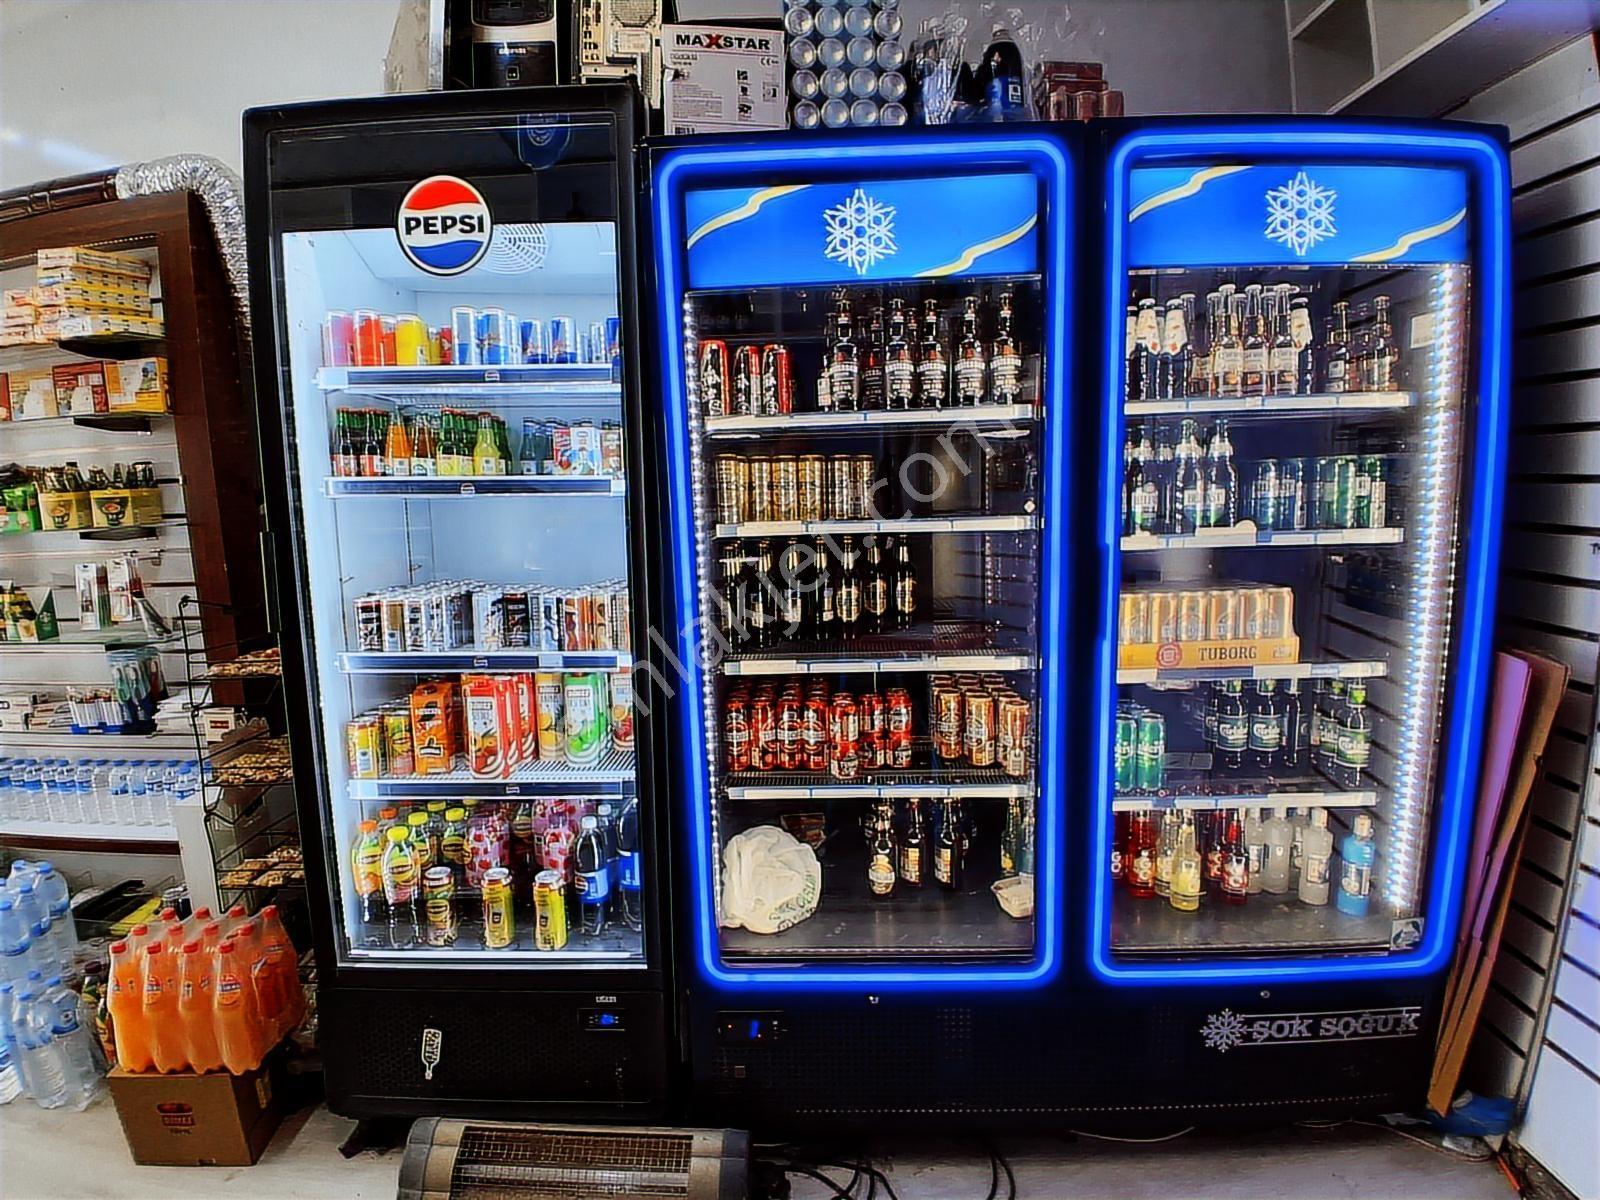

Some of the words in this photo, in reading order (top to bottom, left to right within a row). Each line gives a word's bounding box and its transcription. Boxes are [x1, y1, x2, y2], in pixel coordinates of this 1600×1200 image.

[675, 33, 771, 51] MAXSTAR
[404, 214, 485, 236] PEPSI
[1197, 645, 1258, 662] TUBORG
